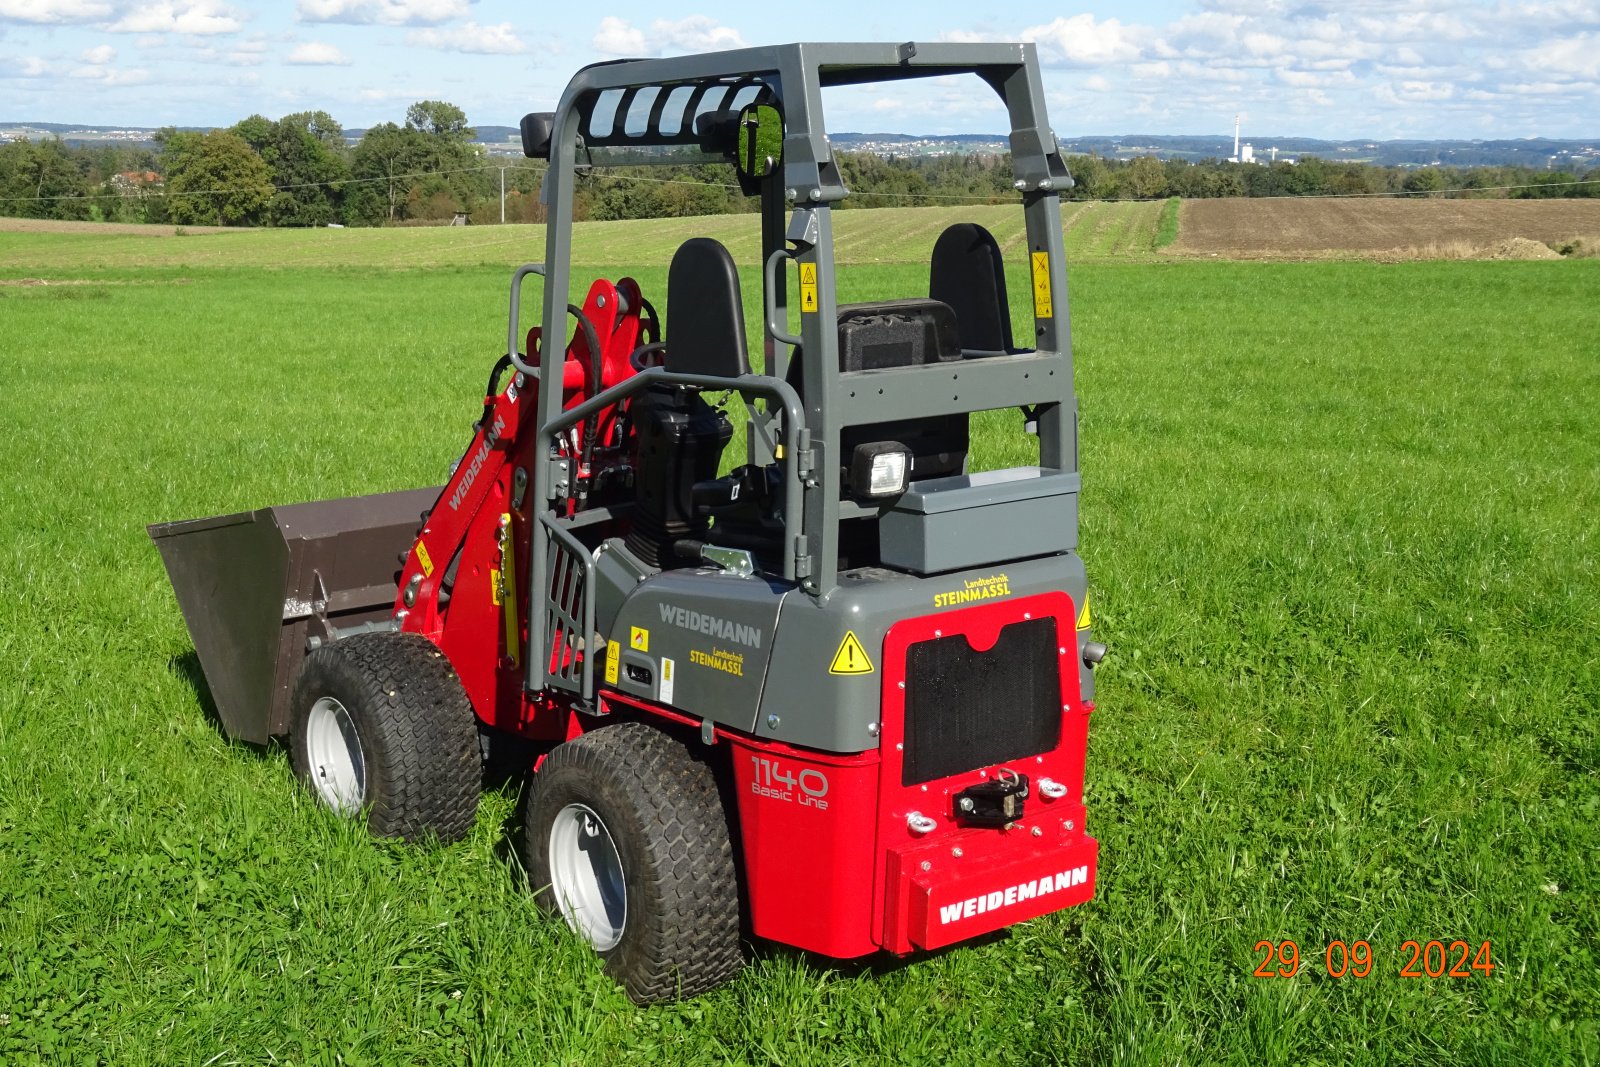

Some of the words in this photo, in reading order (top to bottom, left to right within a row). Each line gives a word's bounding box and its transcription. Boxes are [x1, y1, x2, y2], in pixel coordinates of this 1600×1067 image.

[448, 415, 505, 511] WEIDEMANN
[934, 584, 1011, 608] STEINMASSL
[964, 573, 1009, 590] Landtechnik
[658, 603, 762, 649] WEIDEMANN
[690, 649, 744, 676] STEINMASSL
[713, 646, 744, 664] Landtechnik
[751, 756, 829, 798] 1140
[751, 781, 793, 803] Basic
[797, 793, 829, 811] Line
[939, 865, 1088, 925] WEIDEMANN
